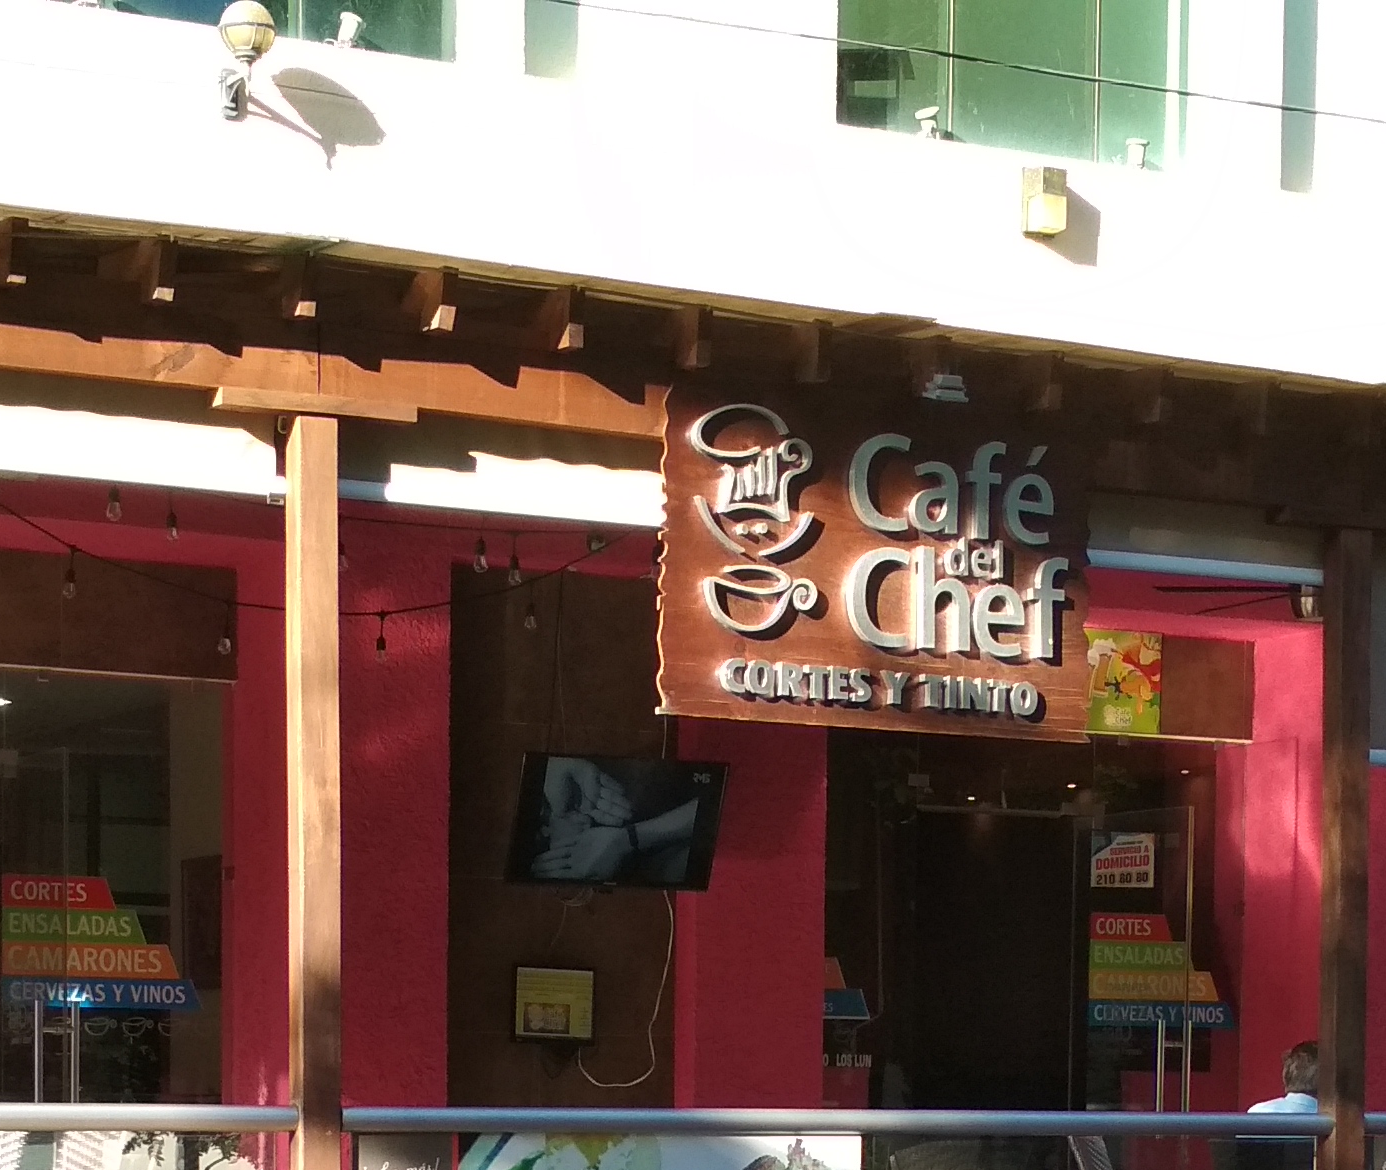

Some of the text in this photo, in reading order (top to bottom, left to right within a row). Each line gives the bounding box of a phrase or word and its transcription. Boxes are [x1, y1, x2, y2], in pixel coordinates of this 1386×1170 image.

[848, 432, 1056, 546] Café
[944, 538, 1004, 580] del
[845, 546, 1070, 660] Chef
[719, 657, 1040, 717] CORTES Y TINTO
[1096, 855, 1150, 870] DOMICILIO
[10, 879, 88, 903] CORTES
[1096, 873, 1116, 885] 210
[7, 910, 132, 937] ENSALADAS
[1095, 917, 1151, 936] CORTES
[8, 945, 162, 974] CAMARONES
[1094, 944, 1184, 966] ENSALADAS
[9, 979, 186, 1004] CERVEZAS Y VINOS
[1093, 973, 1206, 997] CAMARONES
[1094, 1003, 1224, 1023] CERVEZAS Y VINOS
[836, 1053, 852, 1067] LOS
